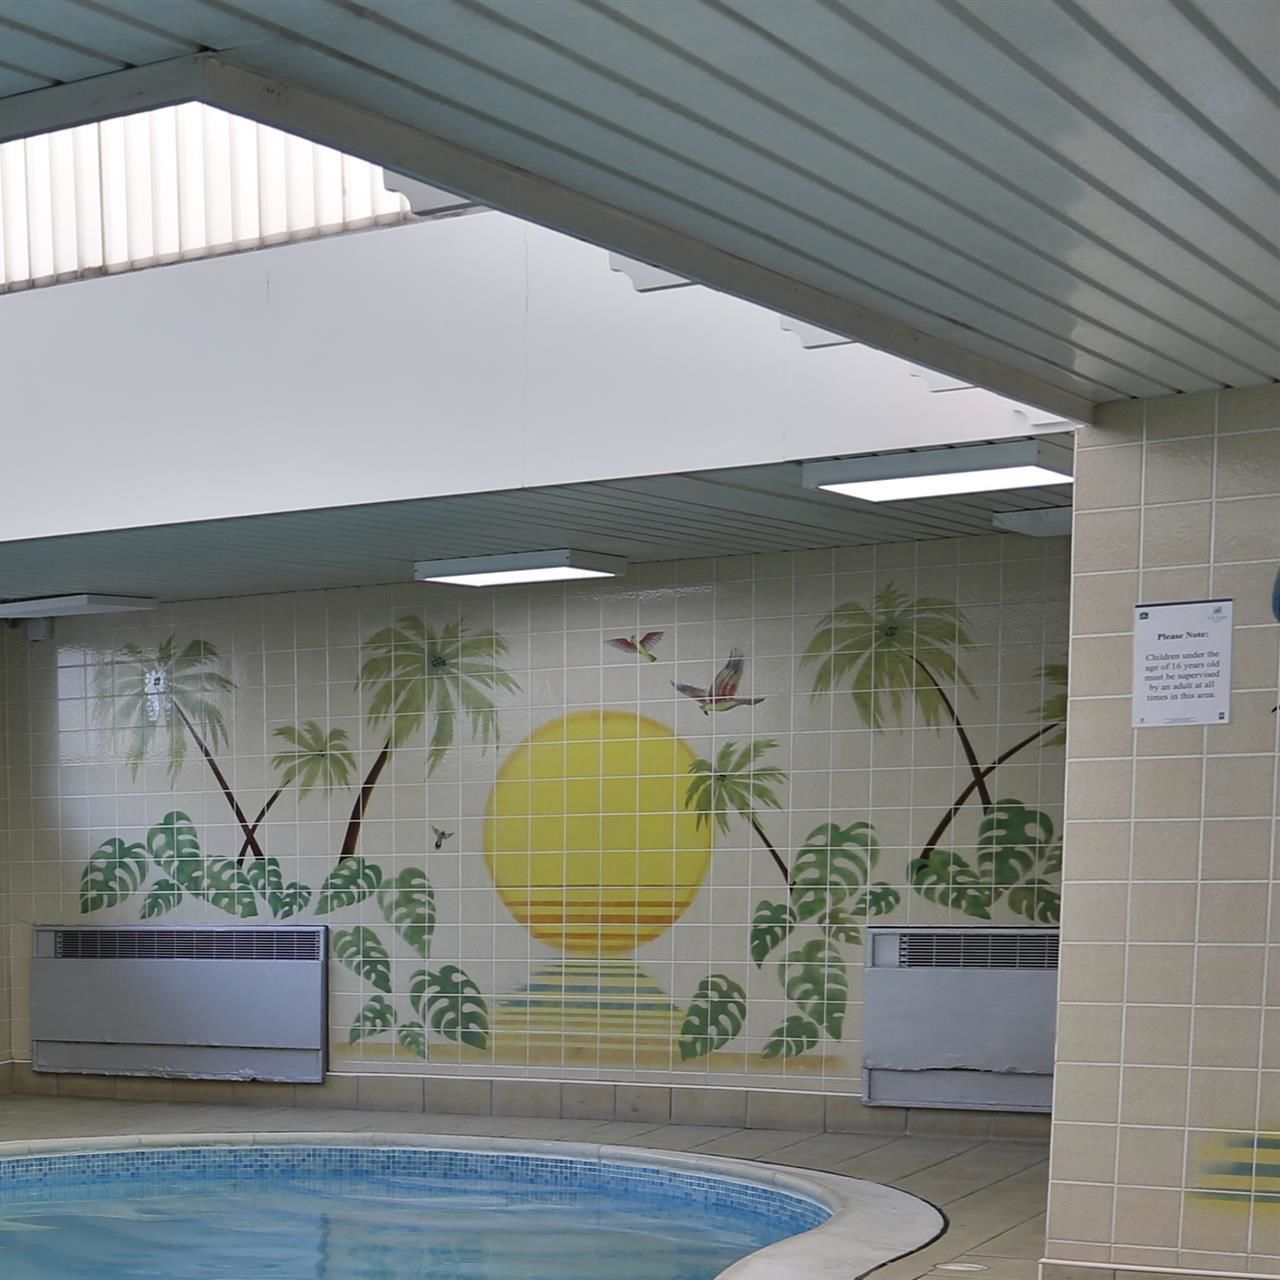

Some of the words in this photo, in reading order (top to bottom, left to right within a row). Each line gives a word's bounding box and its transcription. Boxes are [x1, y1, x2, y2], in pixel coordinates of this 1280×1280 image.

[1183, 662, 1205, 670] years
[1177, 670, 1220, 680] supervised
[1149, 684, 1158, 692] by
[1172, 682, 1193, 690] adult
